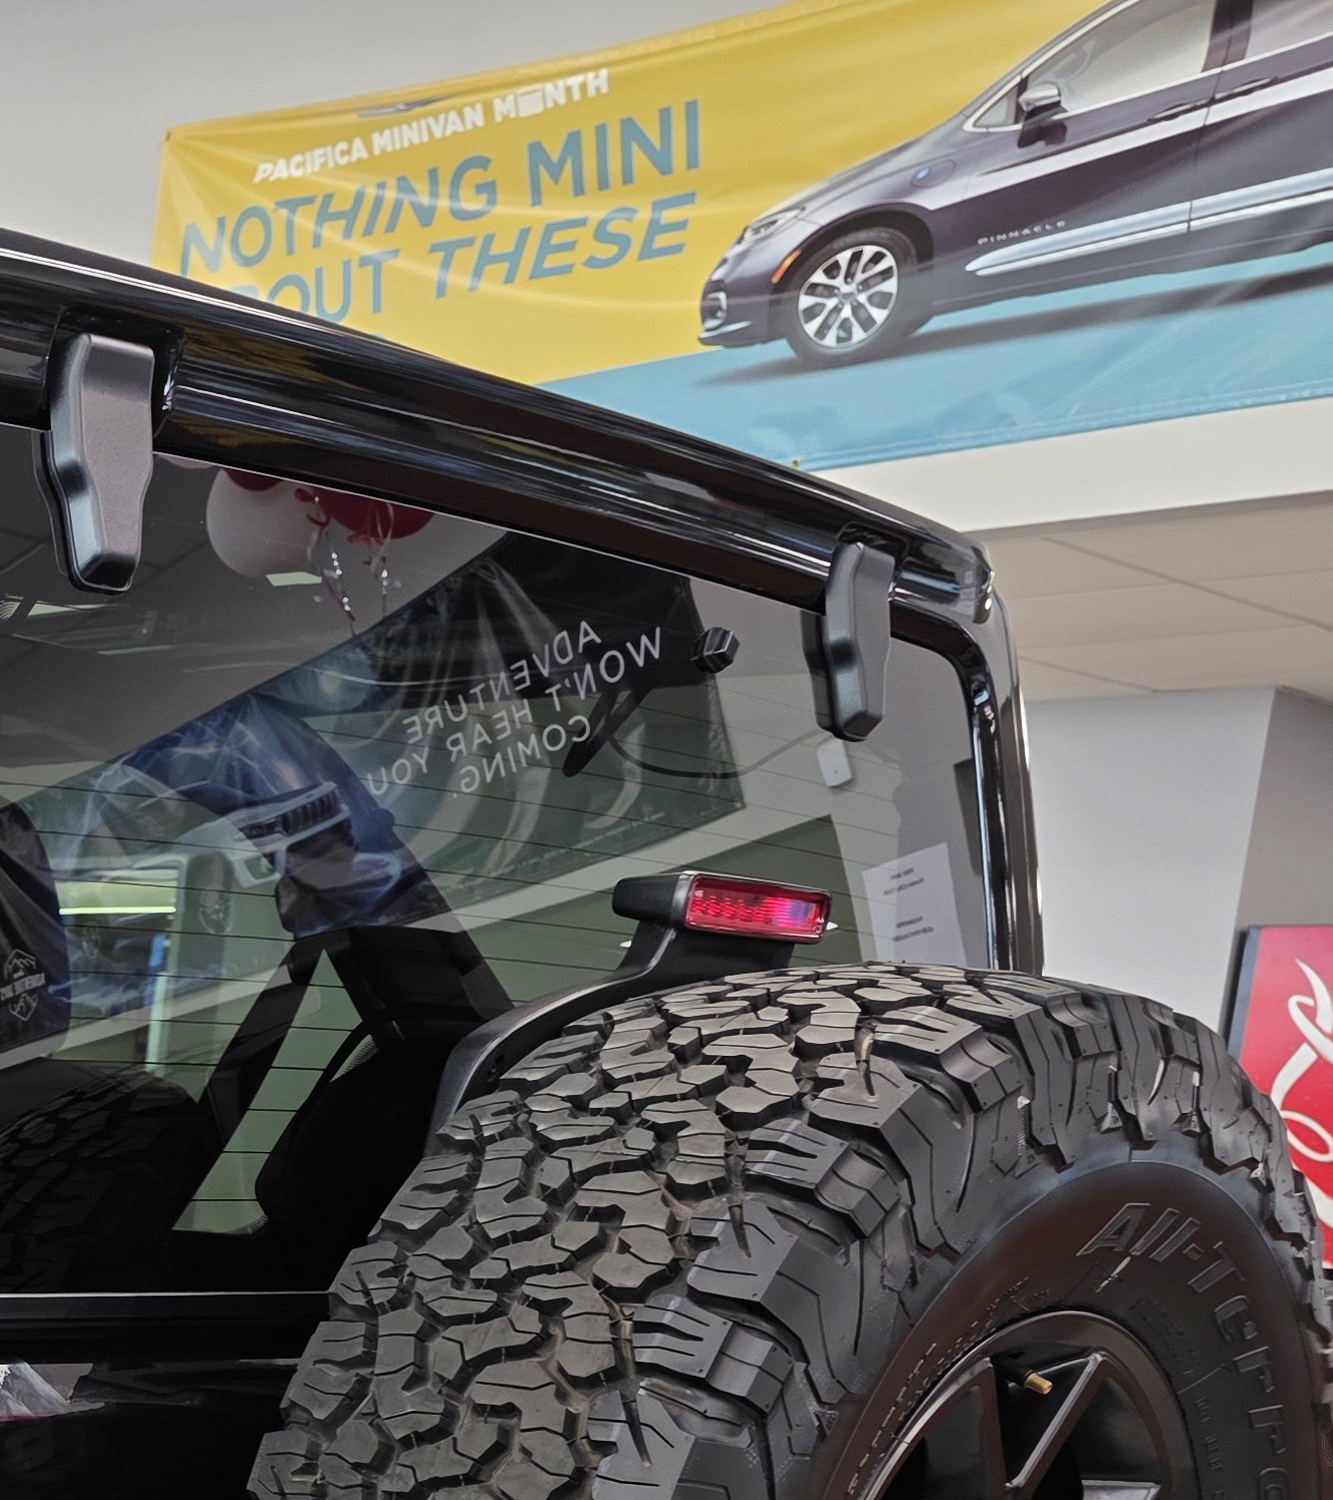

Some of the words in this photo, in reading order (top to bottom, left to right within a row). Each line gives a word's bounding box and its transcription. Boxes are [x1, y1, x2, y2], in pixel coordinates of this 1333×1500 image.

[180, 154, 499, 277] NOTHING
[526, 98, 702, 207] MINI
[253, 139, 367, 183] PACIFICA
[372, 103, 484, 156] MINIVAN
[428, 192, 697, 300] THESE
